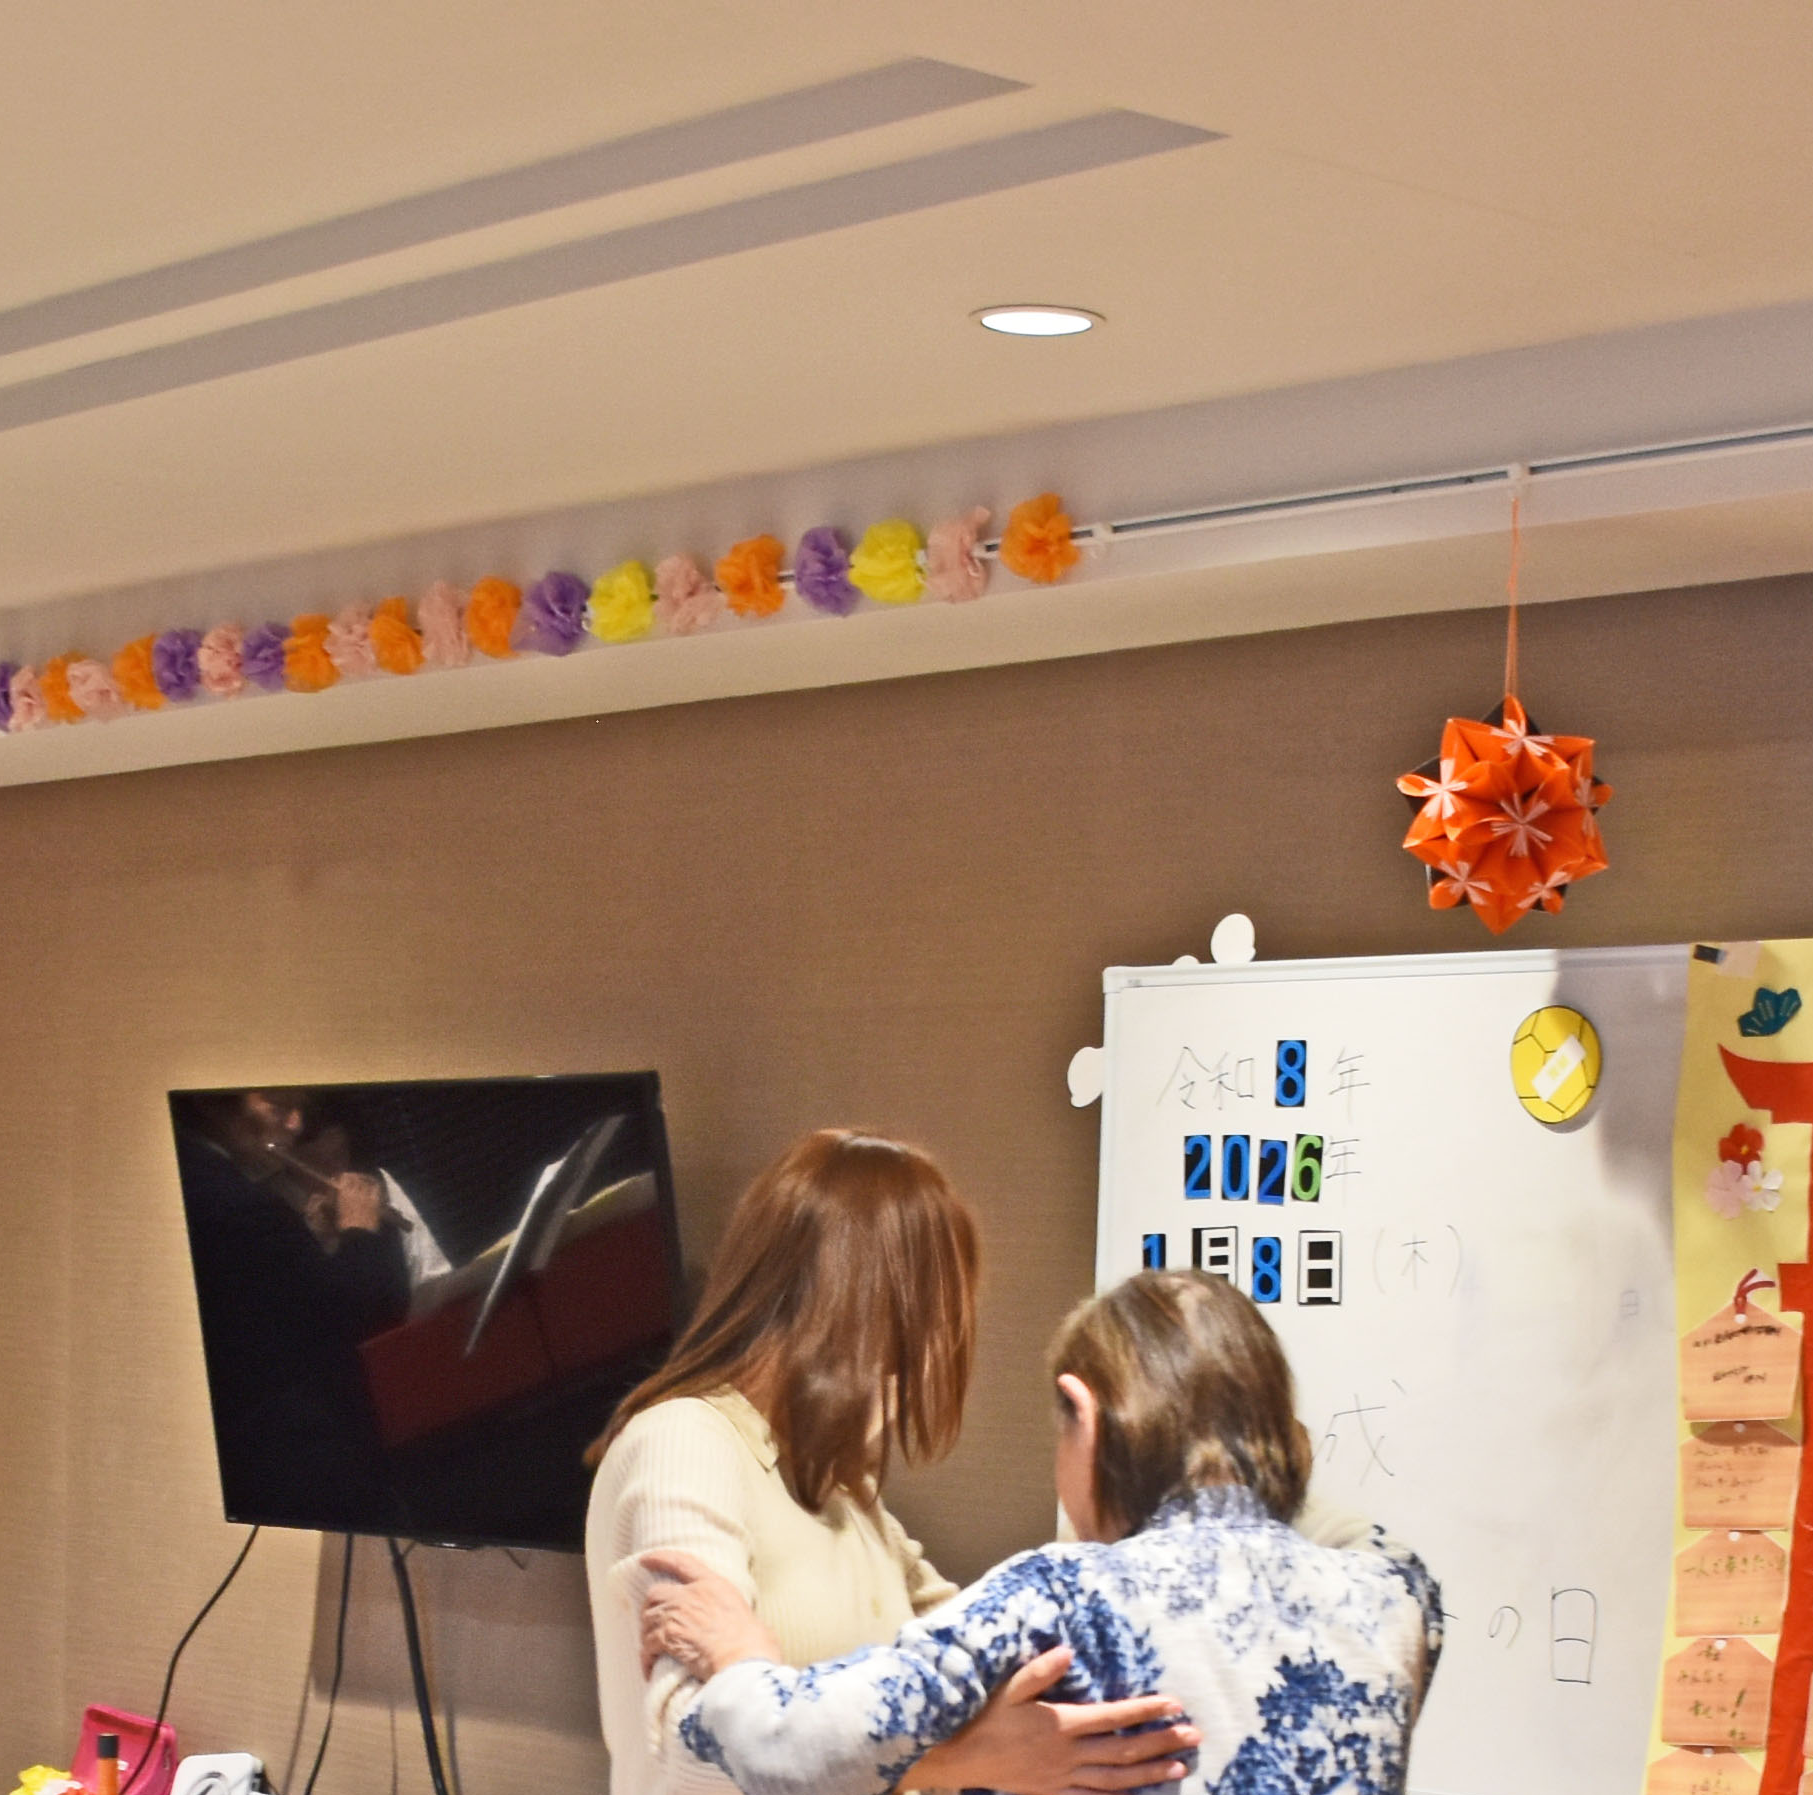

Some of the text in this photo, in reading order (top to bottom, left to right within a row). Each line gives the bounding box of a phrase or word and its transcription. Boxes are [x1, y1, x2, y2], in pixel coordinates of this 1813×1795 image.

[1156, 1039, 1372, 1126] 令和8年
[1183, 1132, 1363, 1206] 2026年
